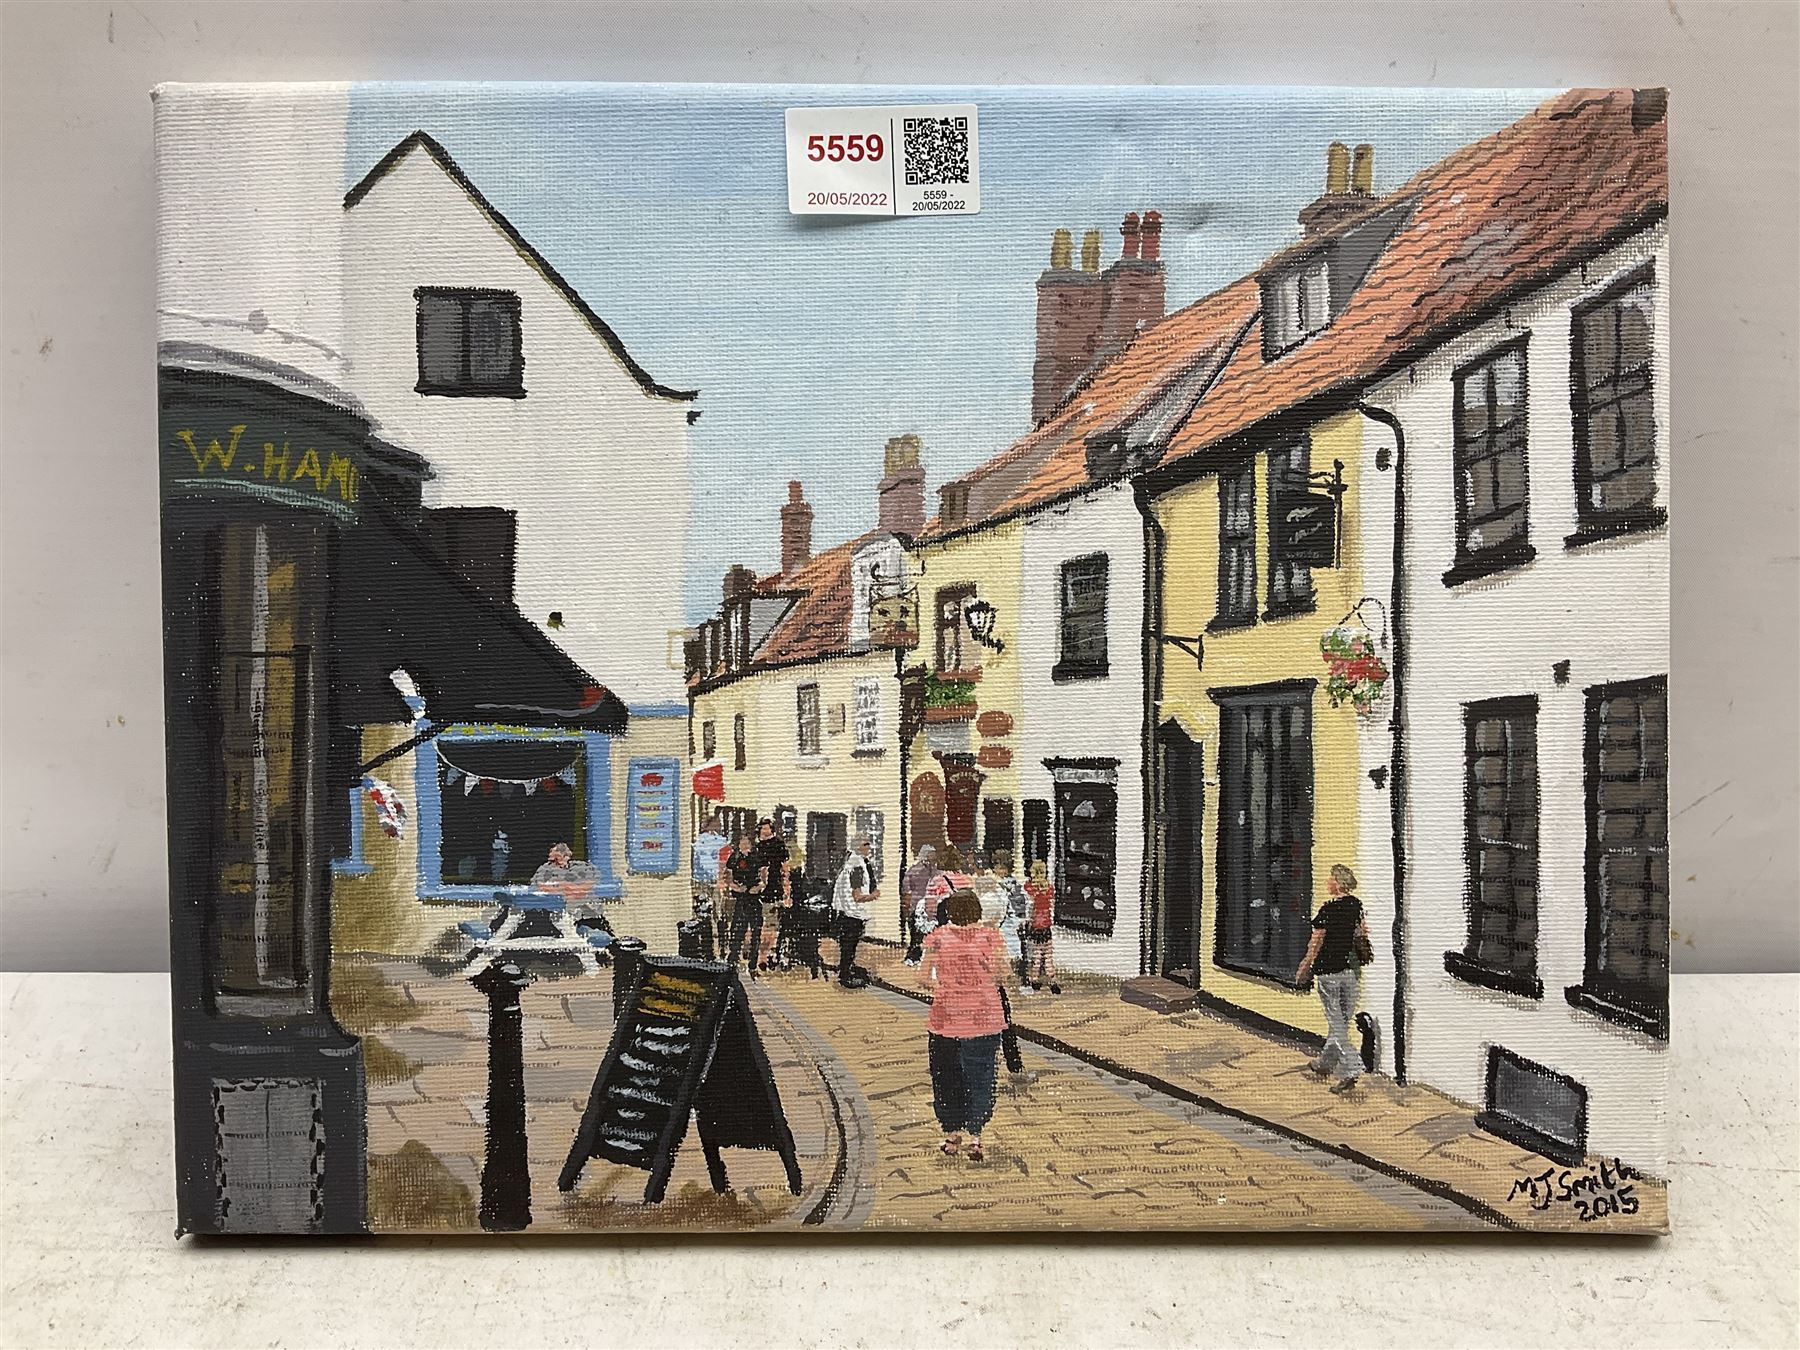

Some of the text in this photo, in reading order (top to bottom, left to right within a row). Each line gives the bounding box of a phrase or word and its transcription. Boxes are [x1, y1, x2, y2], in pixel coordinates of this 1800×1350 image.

[807, 134, 884, 162] 5559
[807, 192, 888, 206] 20/05/2022
[923, 190, 947, 200] 5559
[912, 200, 966, 211] 20/05/2022
[1574, 1184, 1640, 1222] 2015
